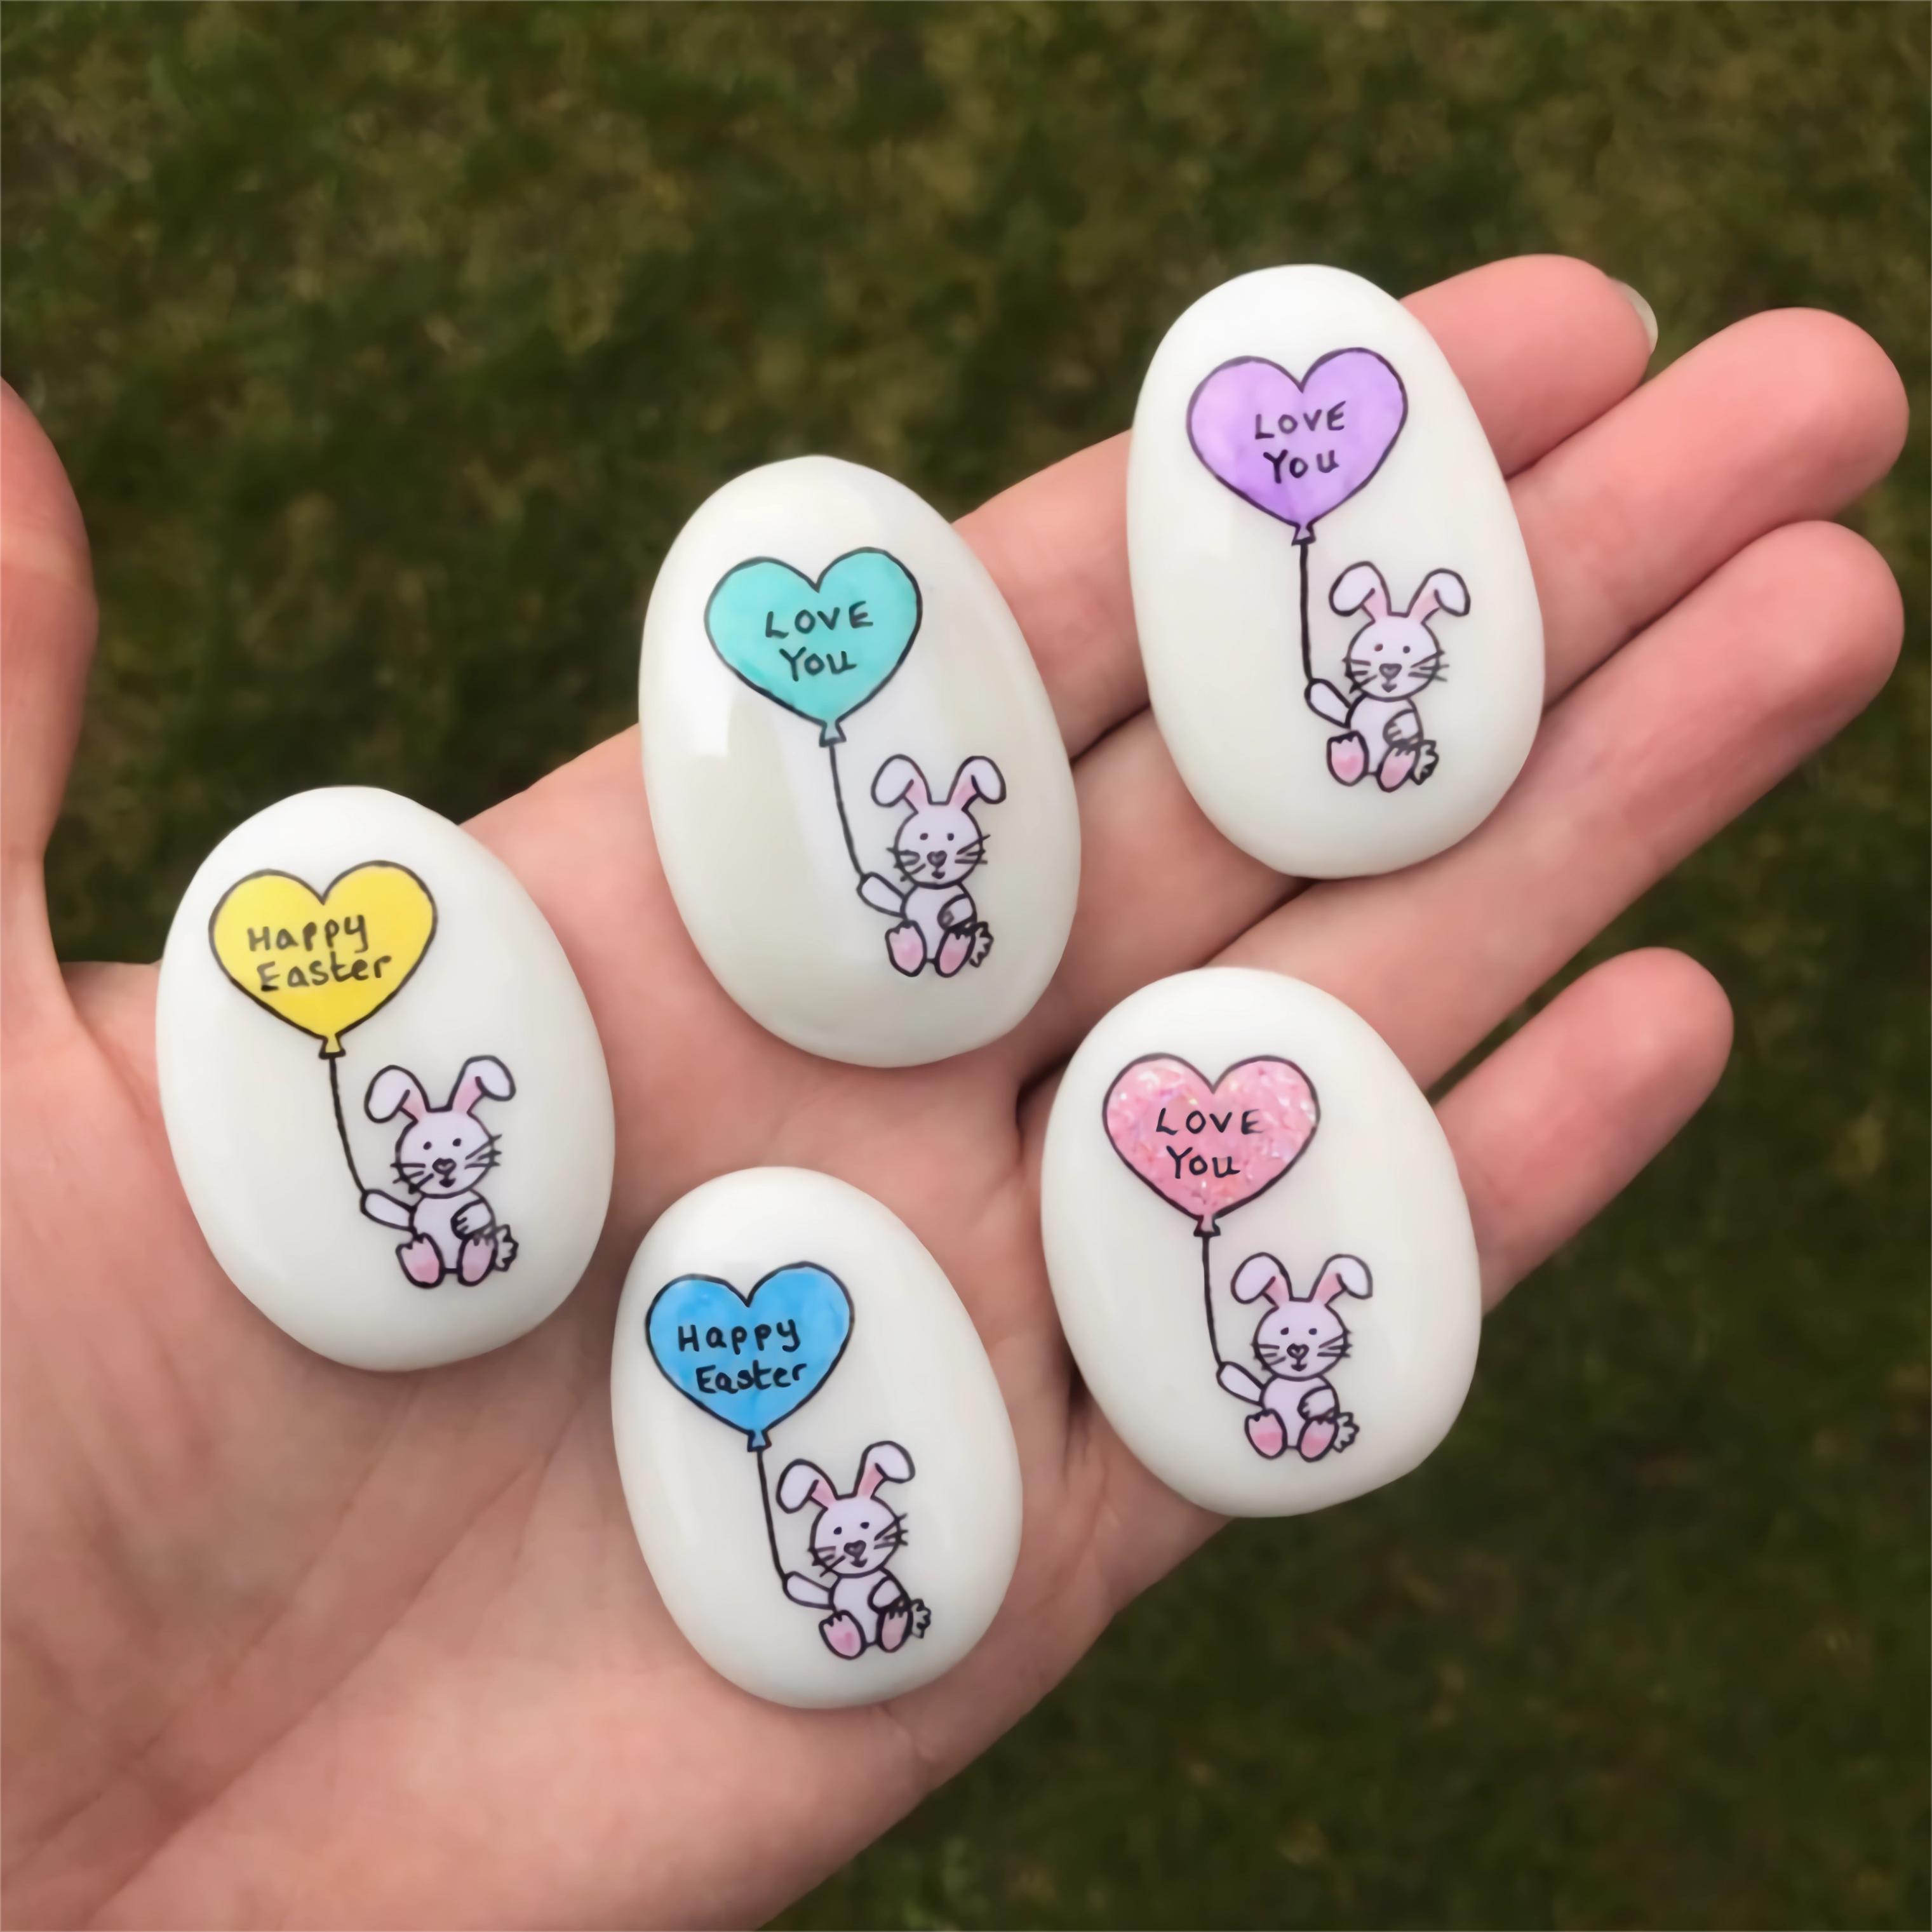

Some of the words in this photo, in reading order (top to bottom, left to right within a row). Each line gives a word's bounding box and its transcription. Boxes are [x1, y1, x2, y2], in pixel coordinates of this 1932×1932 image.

[1255, 401, 1346, 440] LOVE
[765, 600, 874, 640] LOVE
[247, 914, 369, 953] Happy
[257, 951, 392, 993] Easter
[1155, 1107, 1264, 1136] LOVE
[678, 1318, 801, 1355] Happy
[695, 1359, 808, 1394] Easter
